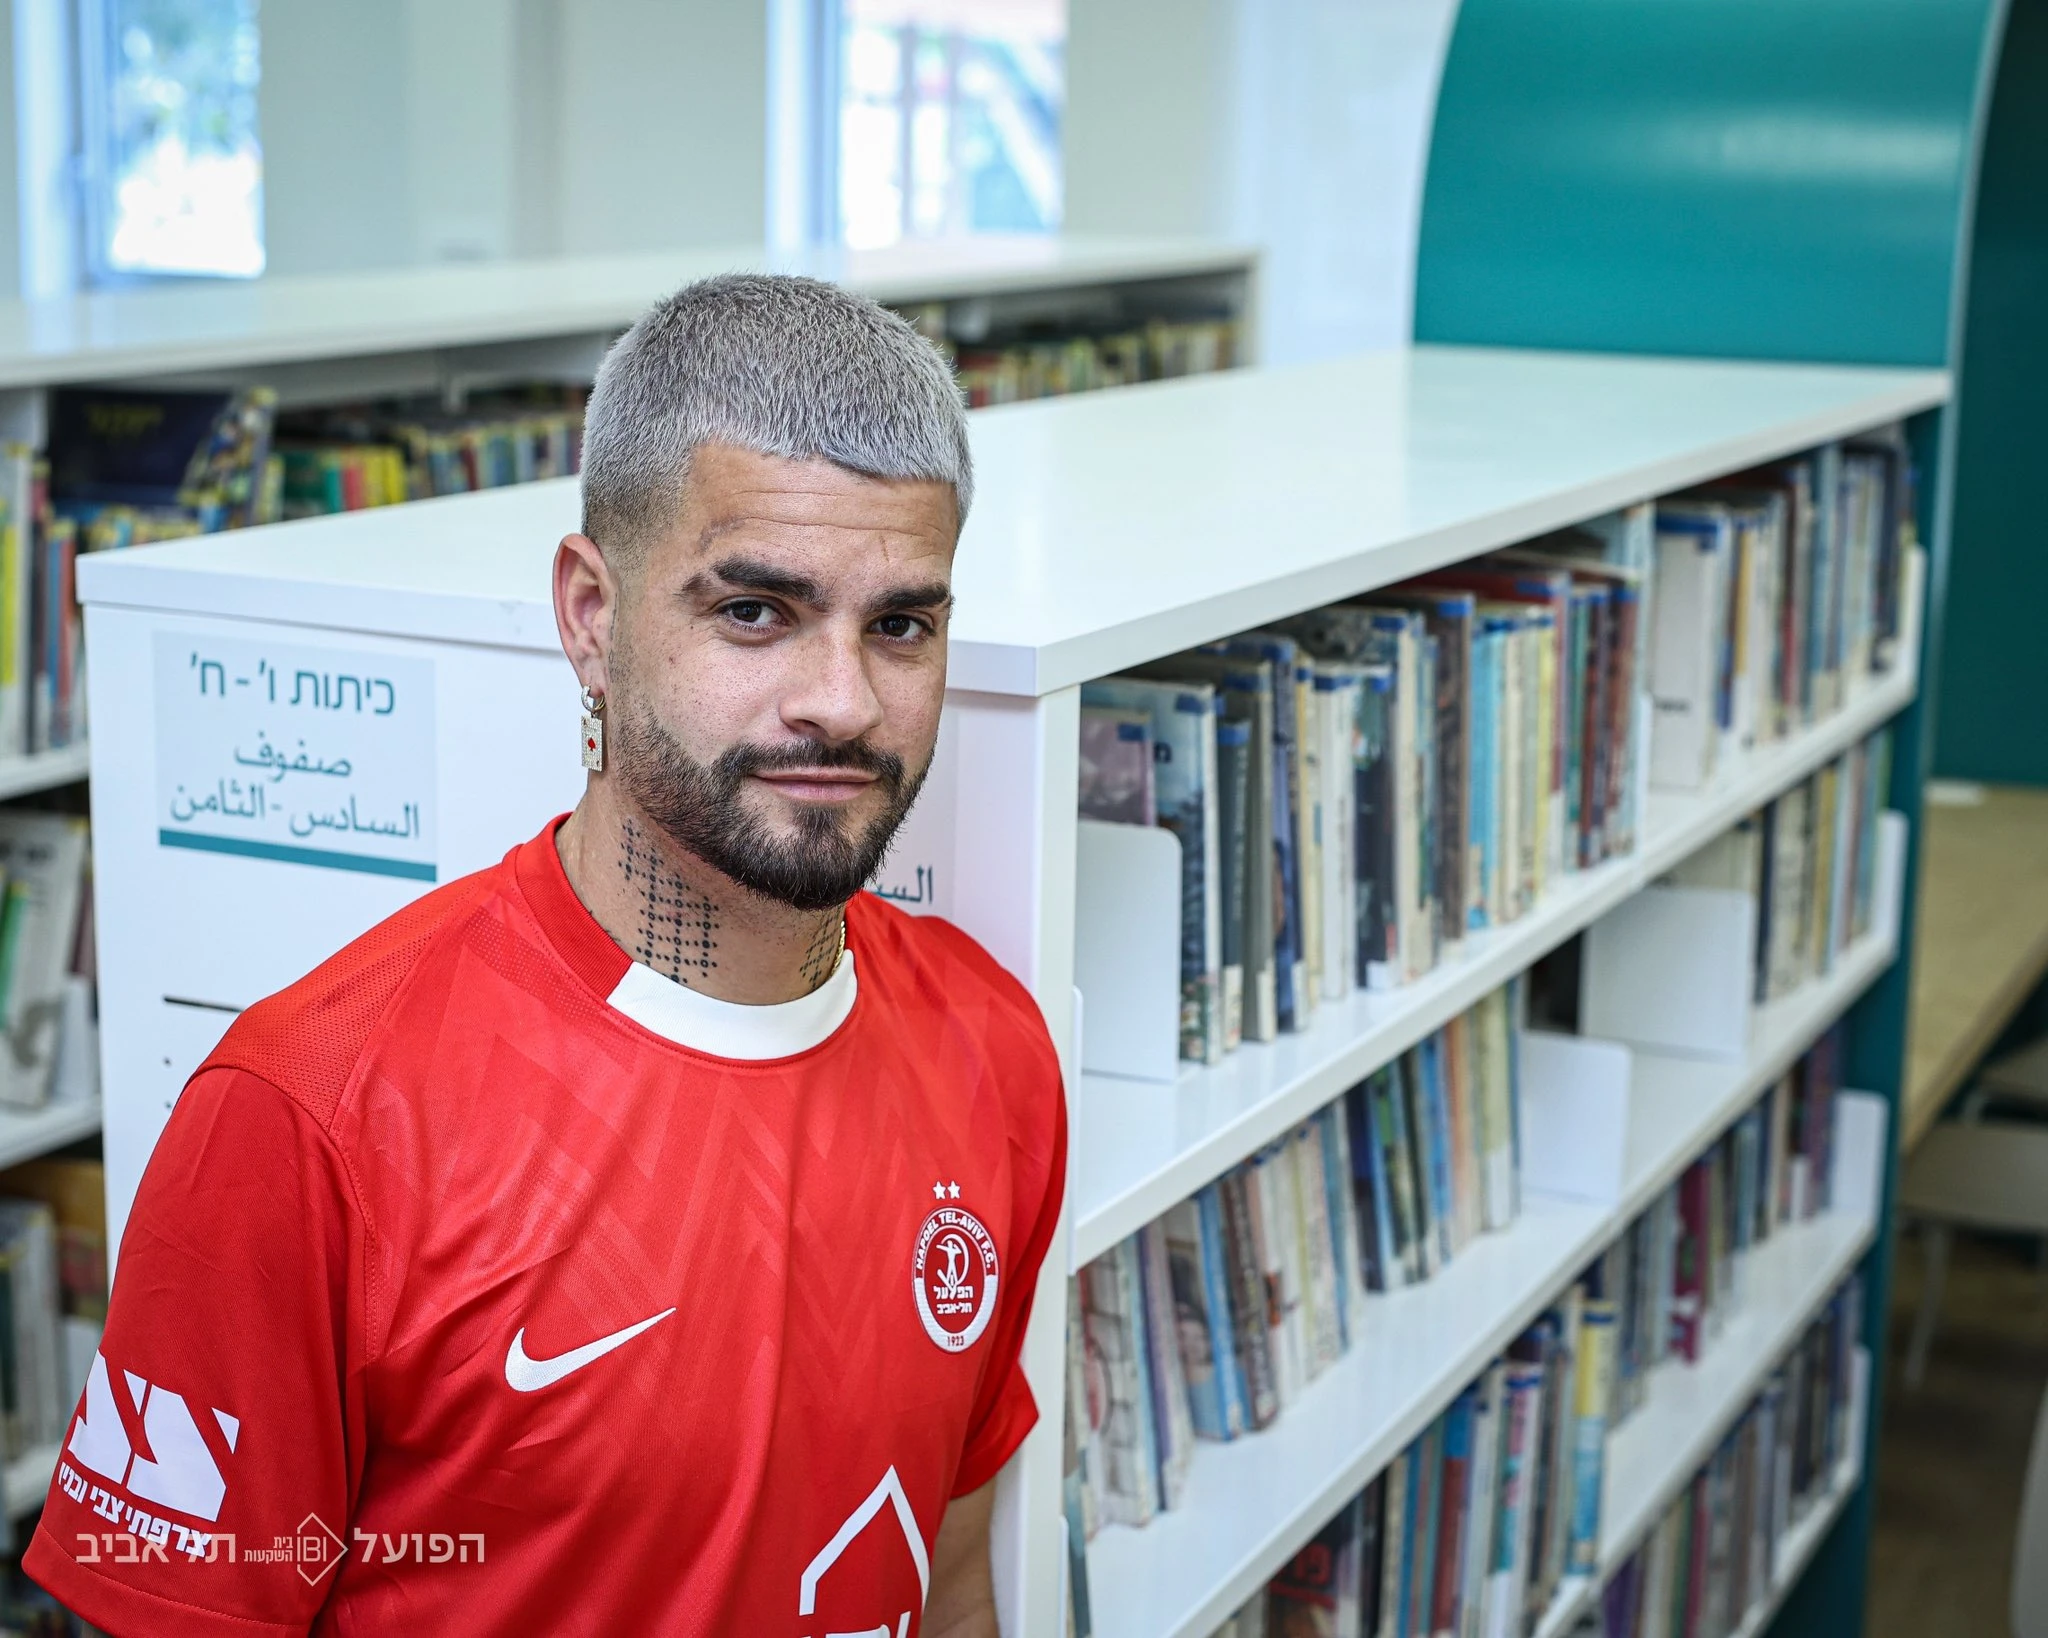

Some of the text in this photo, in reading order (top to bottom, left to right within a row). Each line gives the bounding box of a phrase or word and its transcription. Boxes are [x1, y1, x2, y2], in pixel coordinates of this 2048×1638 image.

[290, 669, 396, 716] כיתות
[234, 730, 353, 782] صفوف
[916, 1211, 995, 1270] HAPOEL TEL-AVIV F.C.
[947, 1335, 965, 1347] 1923
[89, 1484, 126, 1525] צבי
[125, 1505, 214, 1558] צרפתי
